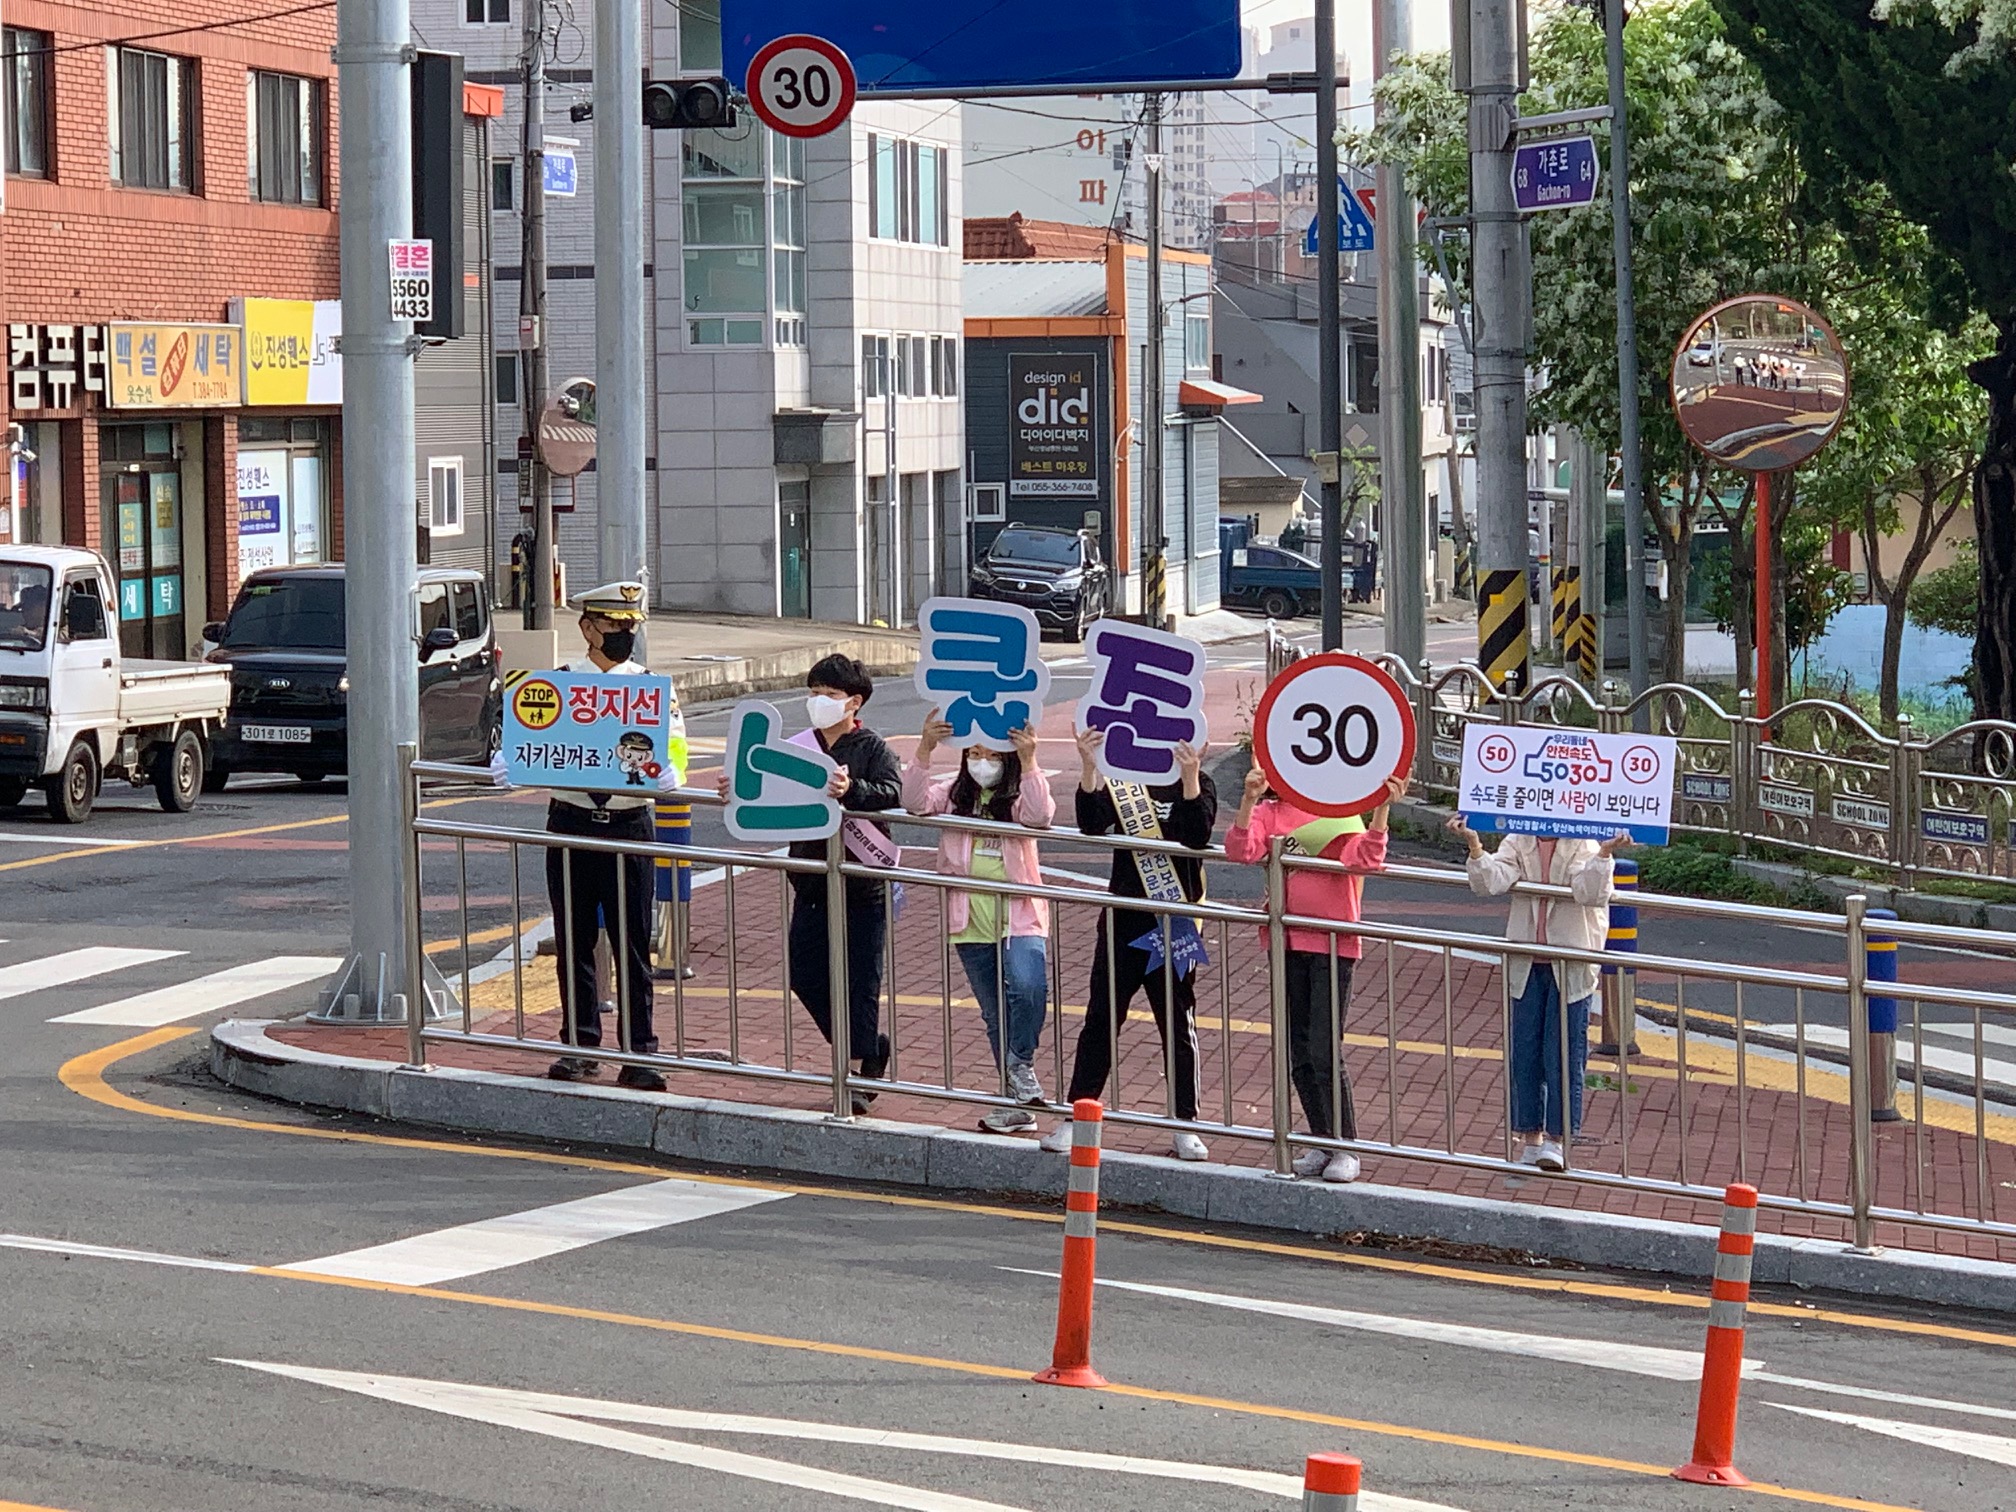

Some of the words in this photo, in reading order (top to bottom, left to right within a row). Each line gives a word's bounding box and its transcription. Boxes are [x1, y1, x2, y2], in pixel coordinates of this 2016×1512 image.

[774, 65, 830, 109] 30
[1538, 147, 1568, 177] 가촌로
[1581, 160, 1591, 181] 64
[1516, 168, 1528, 188] 68
[1537, 183, 1570, 201] Gachon-ro
[395, 245, 429, 269] 결혼
[392, 279, 430, 297] 5560
[393, 299, 430, 318] 4433
[116, 332, 157, 377] 백설
[194, 333, 231, 377] 세탁
[10, 323, 110, 409] 컴퓨터
[1024, 371, 1066, 386] design
[1069, 371, 1082, 384] id
[523, 688, 553, 701] STOP
[568, 686, 661, 726] 정지선
[279, 728, 307, 740] 1085
[1291, 703, 1379, 767] 30
[1553, 734, 1588, 746] 우리동네
[1486, 747, 1508, 761] 50
[1546, 745, 1592, 761] 안전속도
[1541, 762, 1597, 785] 5030
[1630, 757, 1652, 772] 30
[1686, 780, 1711, 795] SCHOOL
[1713, 783, 1730, 796] ZONE
[1470, 783, 1508, 808] 속도를
[1513, 787, 1554, 811] 줄이면
[1558, 790, 1601, 814] 사람이
[1605, 794, 1660, 817] 보입니다
[1762, 788, 1811, 811] 어린이보호구역
[1837, 802, 1866, 821] SCHOOL
[1869, 808, 1888, 825] ZONE
[1508, 818, 1547, 832] 양산경찰서
[1925, 817, 1985, 838] 어린이보호구역
